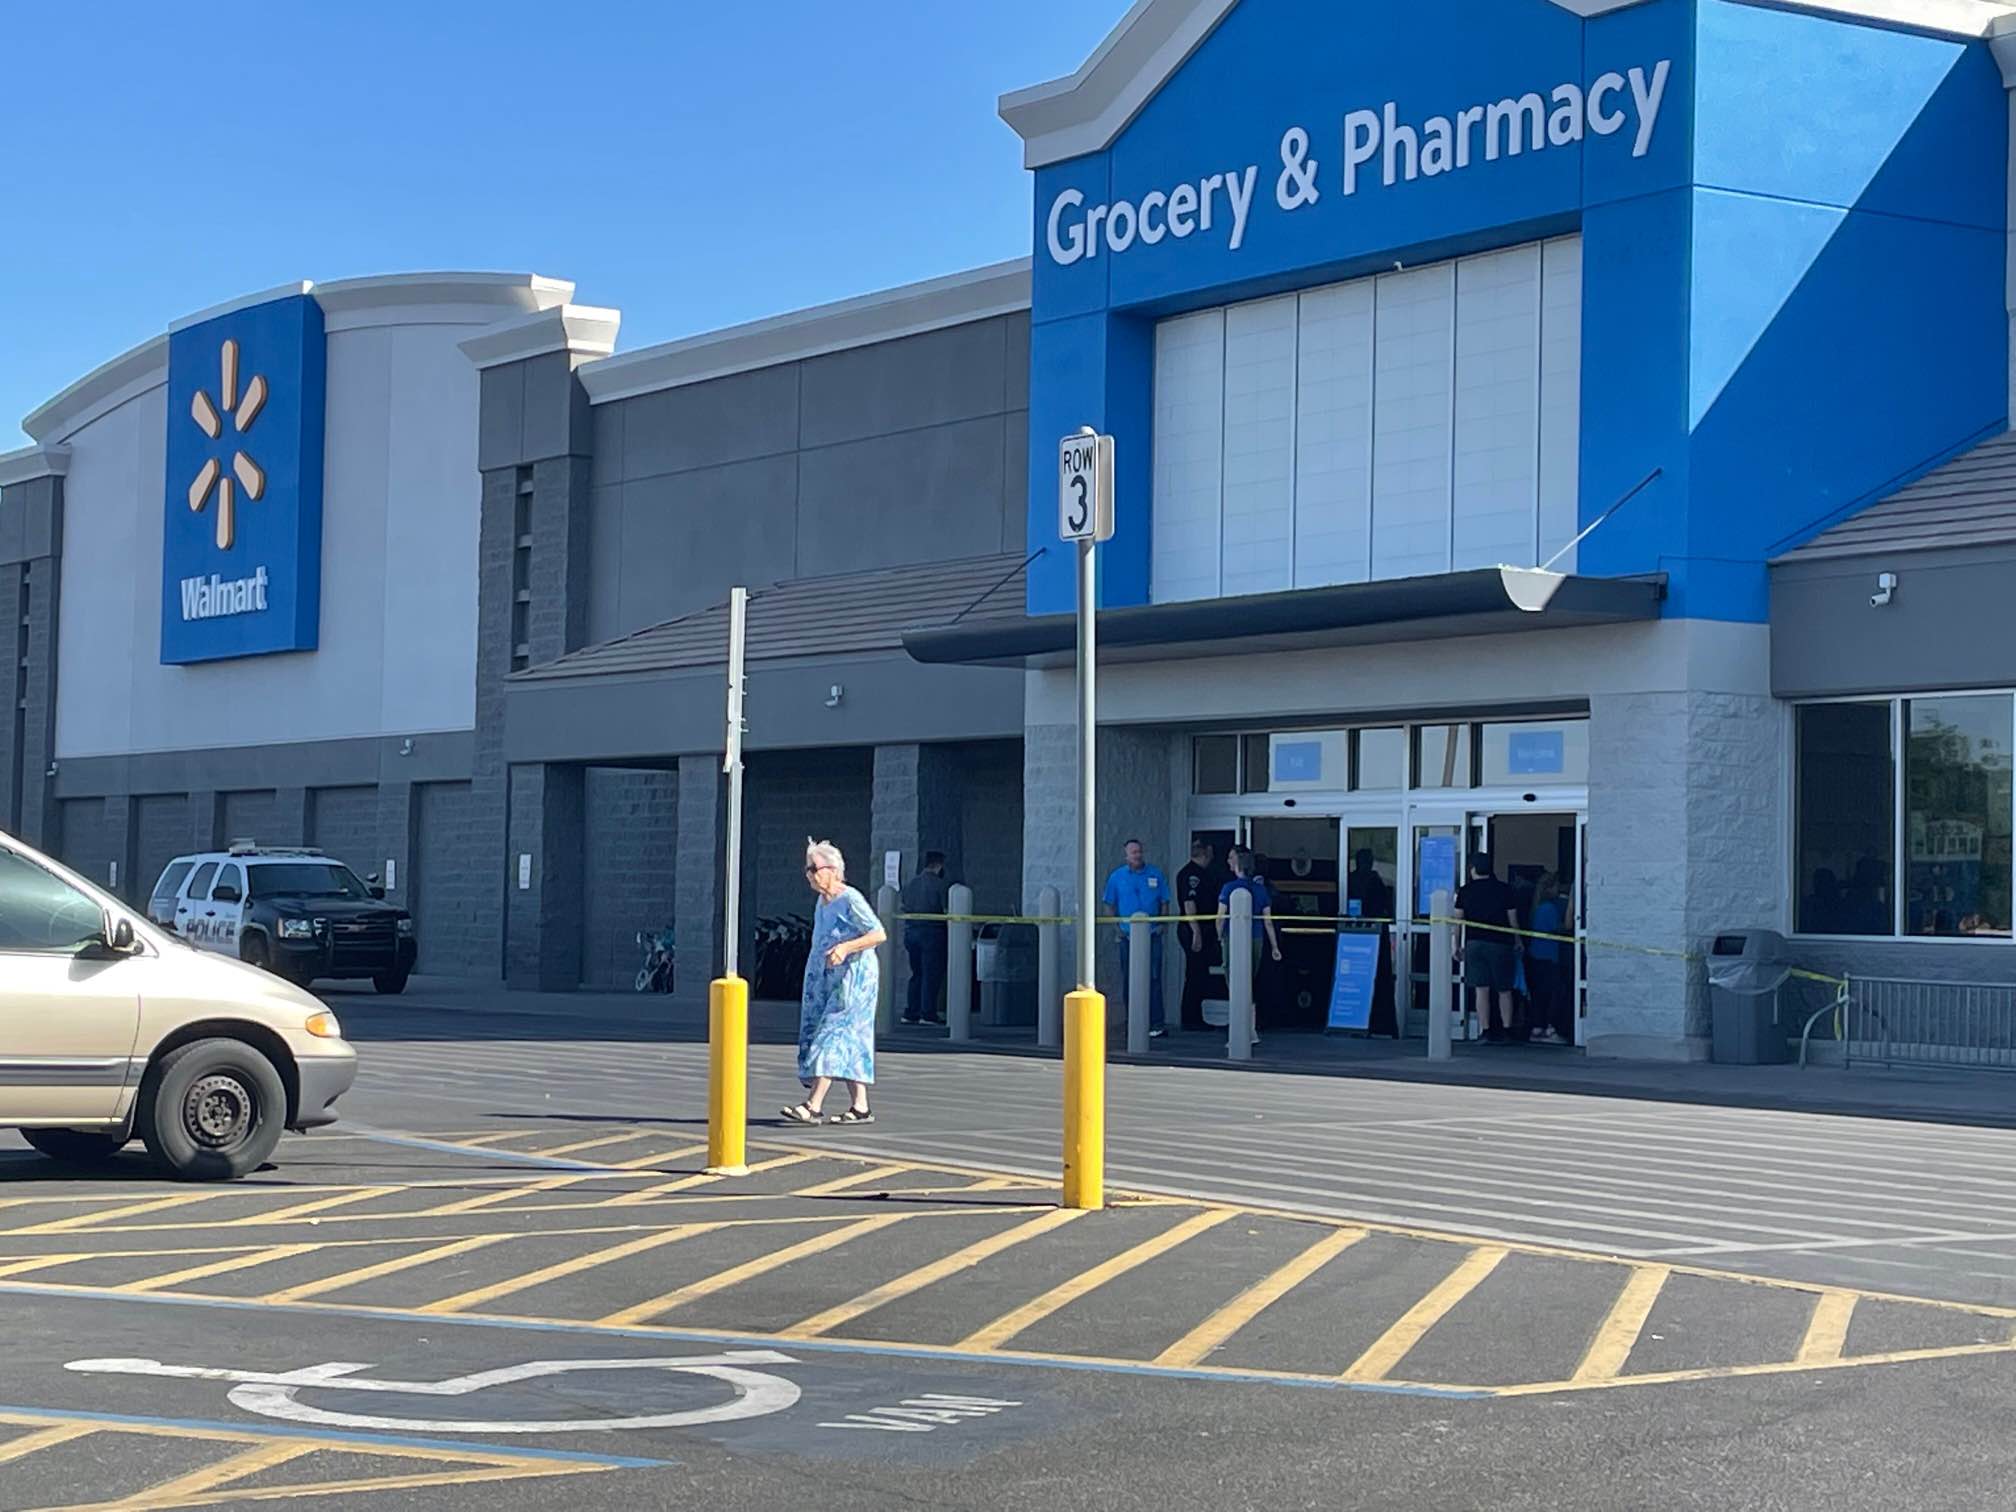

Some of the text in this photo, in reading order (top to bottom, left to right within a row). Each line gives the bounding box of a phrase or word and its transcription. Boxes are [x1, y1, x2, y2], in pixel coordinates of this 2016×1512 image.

[1047, 59, 1671, 266] Grocery & Pharmacy
[1063, 446, 1094, 474] ROW
[1068, 474, 1088, 533] 3
[181, 565, 269, 621] Walmart
[186, 918, 236, 944] POLICE
[816, 1393, 1024, 1432] VAN
